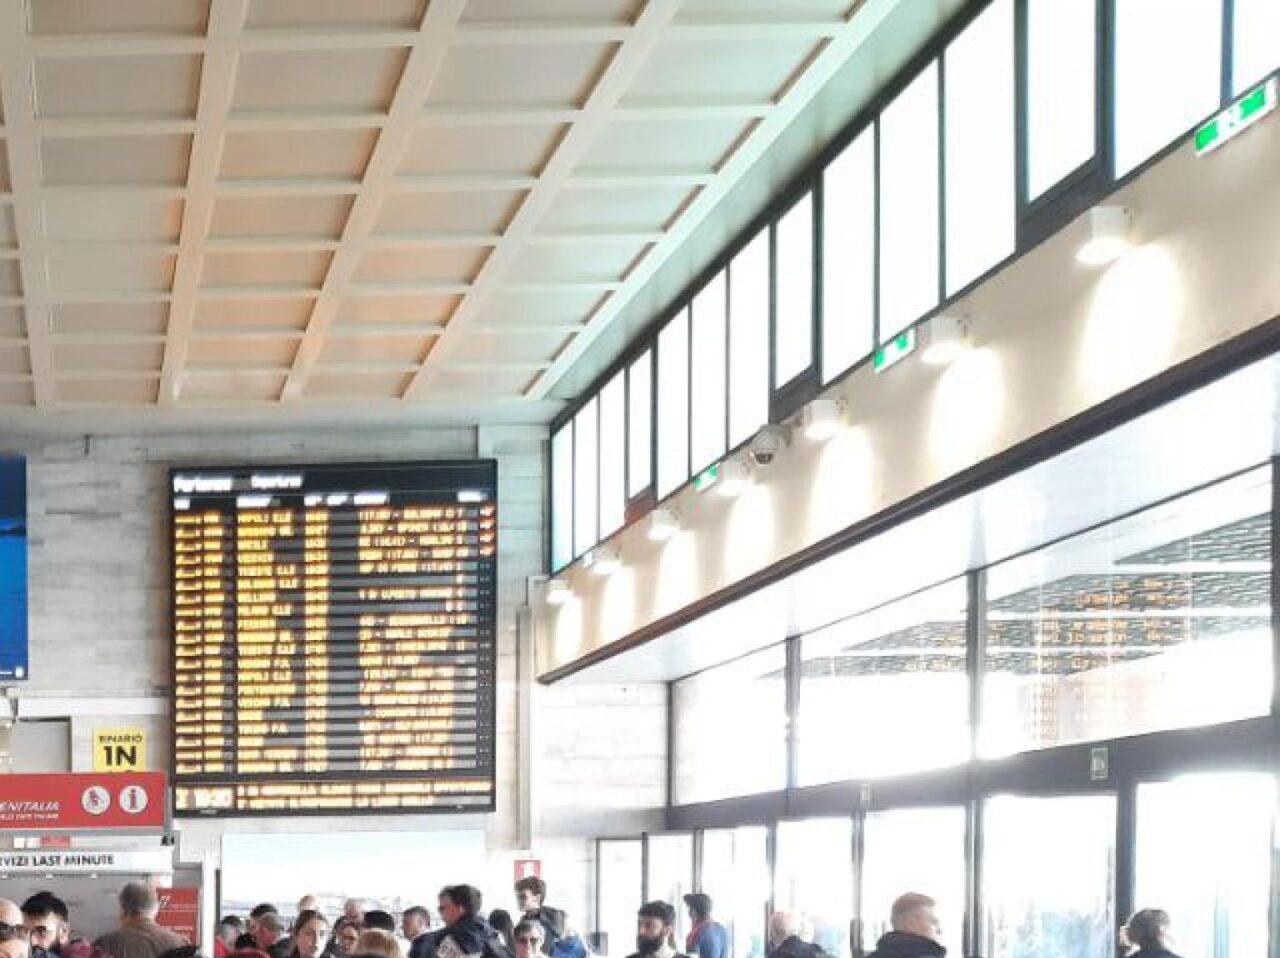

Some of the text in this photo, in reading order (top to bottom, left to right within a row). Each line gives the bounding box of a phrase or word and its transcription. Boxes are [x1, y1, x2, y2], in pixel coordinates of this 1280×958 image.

[103, 745, 136, 767] 1N
[33, 855, 61, 867] LAST
[64, 855, 114, 865] MINUTE
